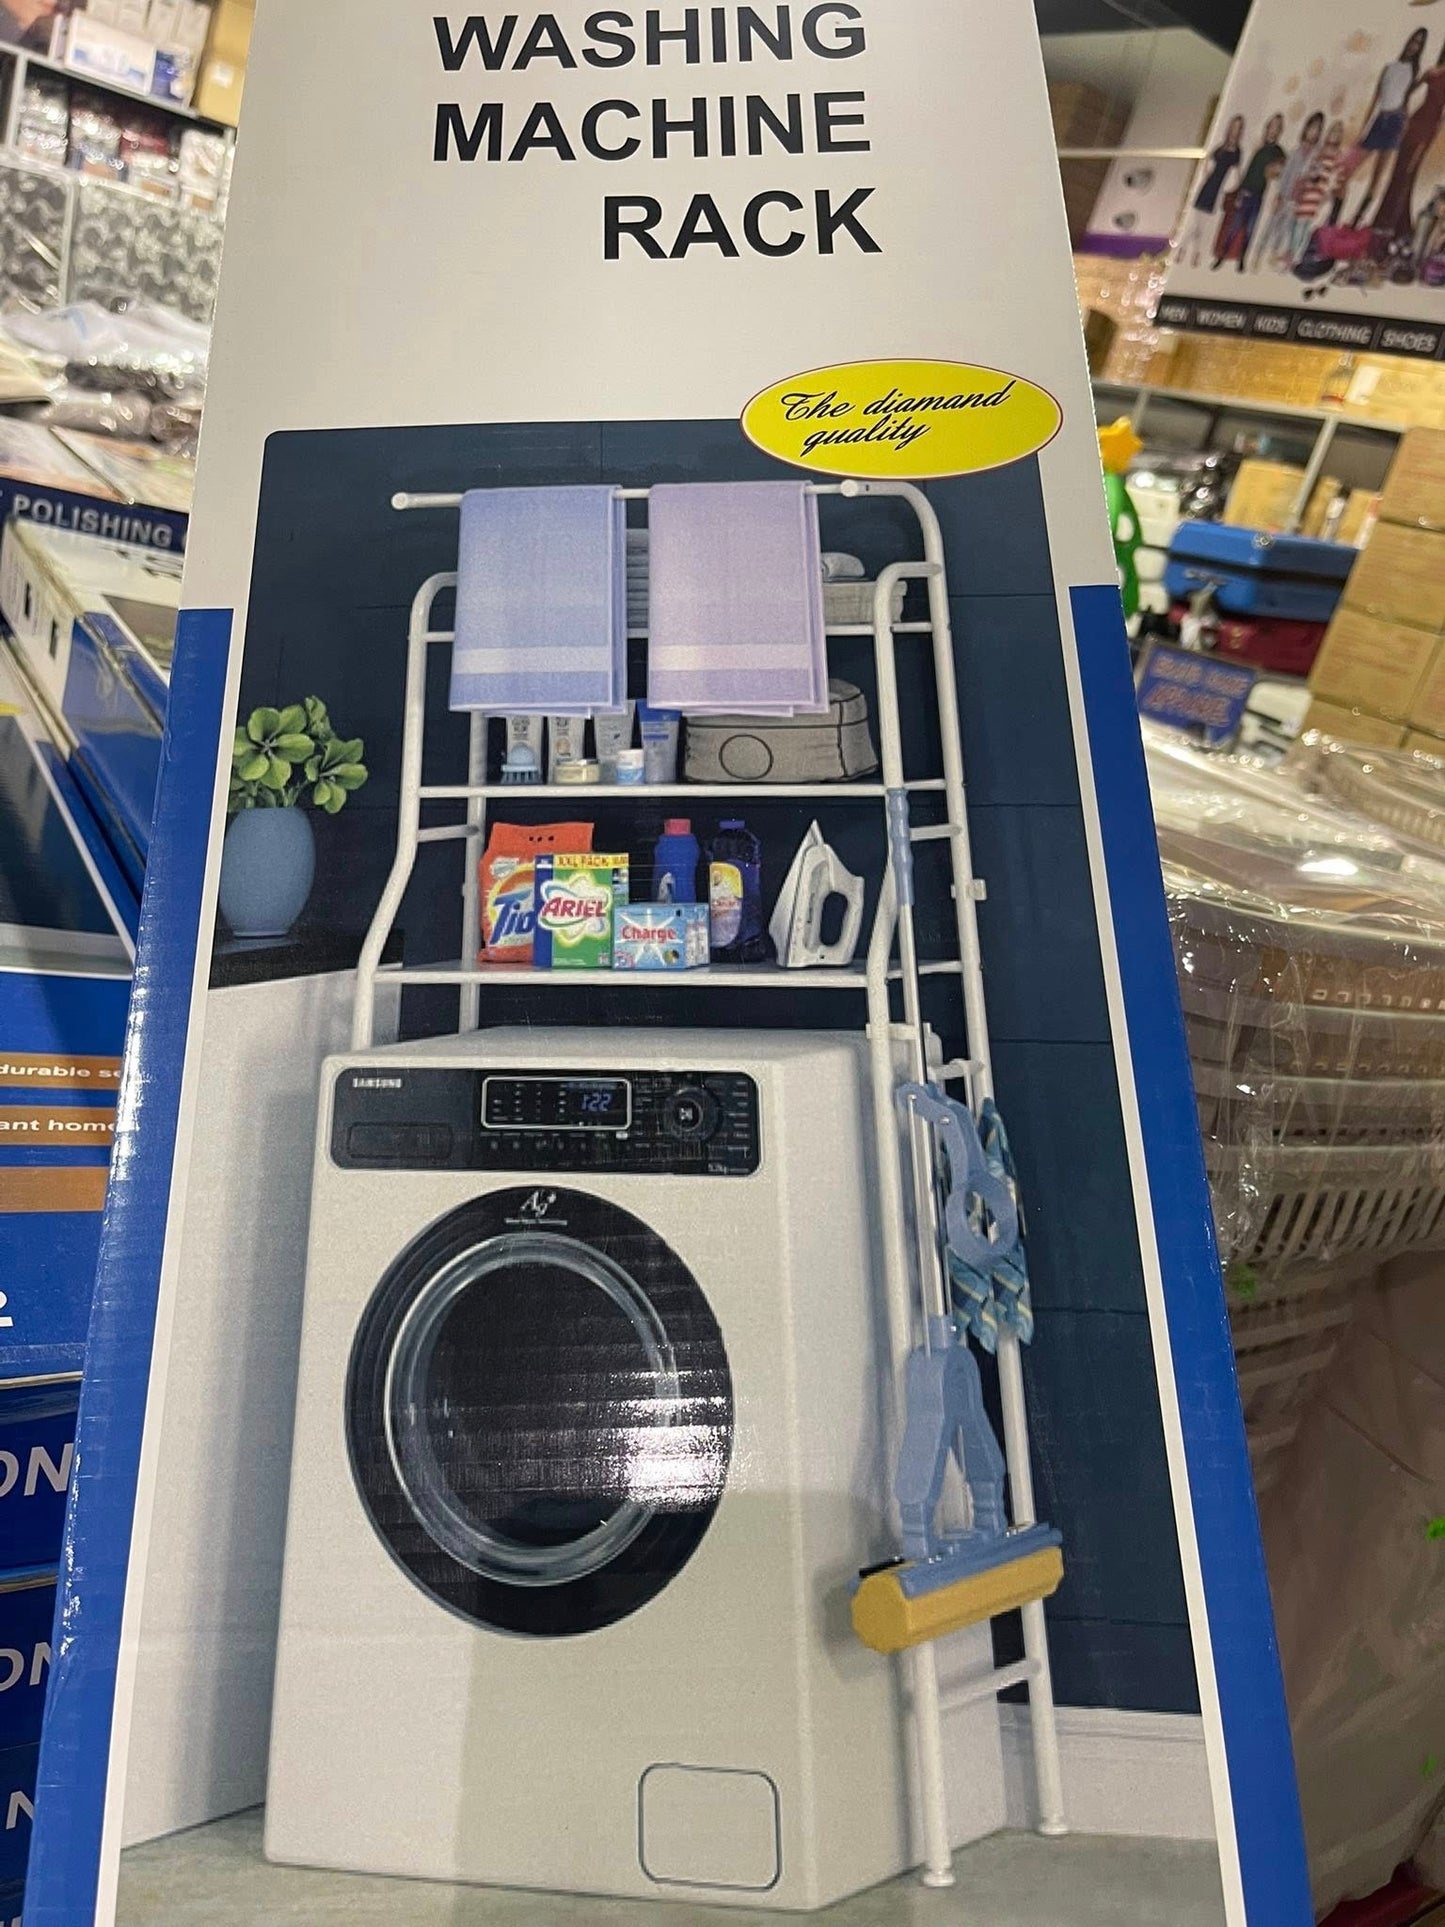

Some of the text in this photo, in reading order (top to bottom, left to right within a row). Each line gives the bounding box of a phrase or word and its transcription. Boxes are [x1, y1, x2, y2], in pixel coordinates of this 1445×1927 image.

[433, 2, 866, 71] WASHING
[433, 91, 870, 162] MACHINE
[603, 187, 883, 260] RACK
[1196, 306, 1247, 330] WOMEN
[1254, 314, 1290, 335] KIDS
[1297, 318, 1373, 345] CLOTHING
[1380, 327, 1438, 353] SHOES
[780, 379, 1017, 421] The diamand
[799, 413, 932, 458] quality
[13, 493, 174, 548] POLISHING
[541, 896, 606, 918] ARIEL
[621, 924, 677, 941] Charge
[0, 1064, 91, 1078] durable
